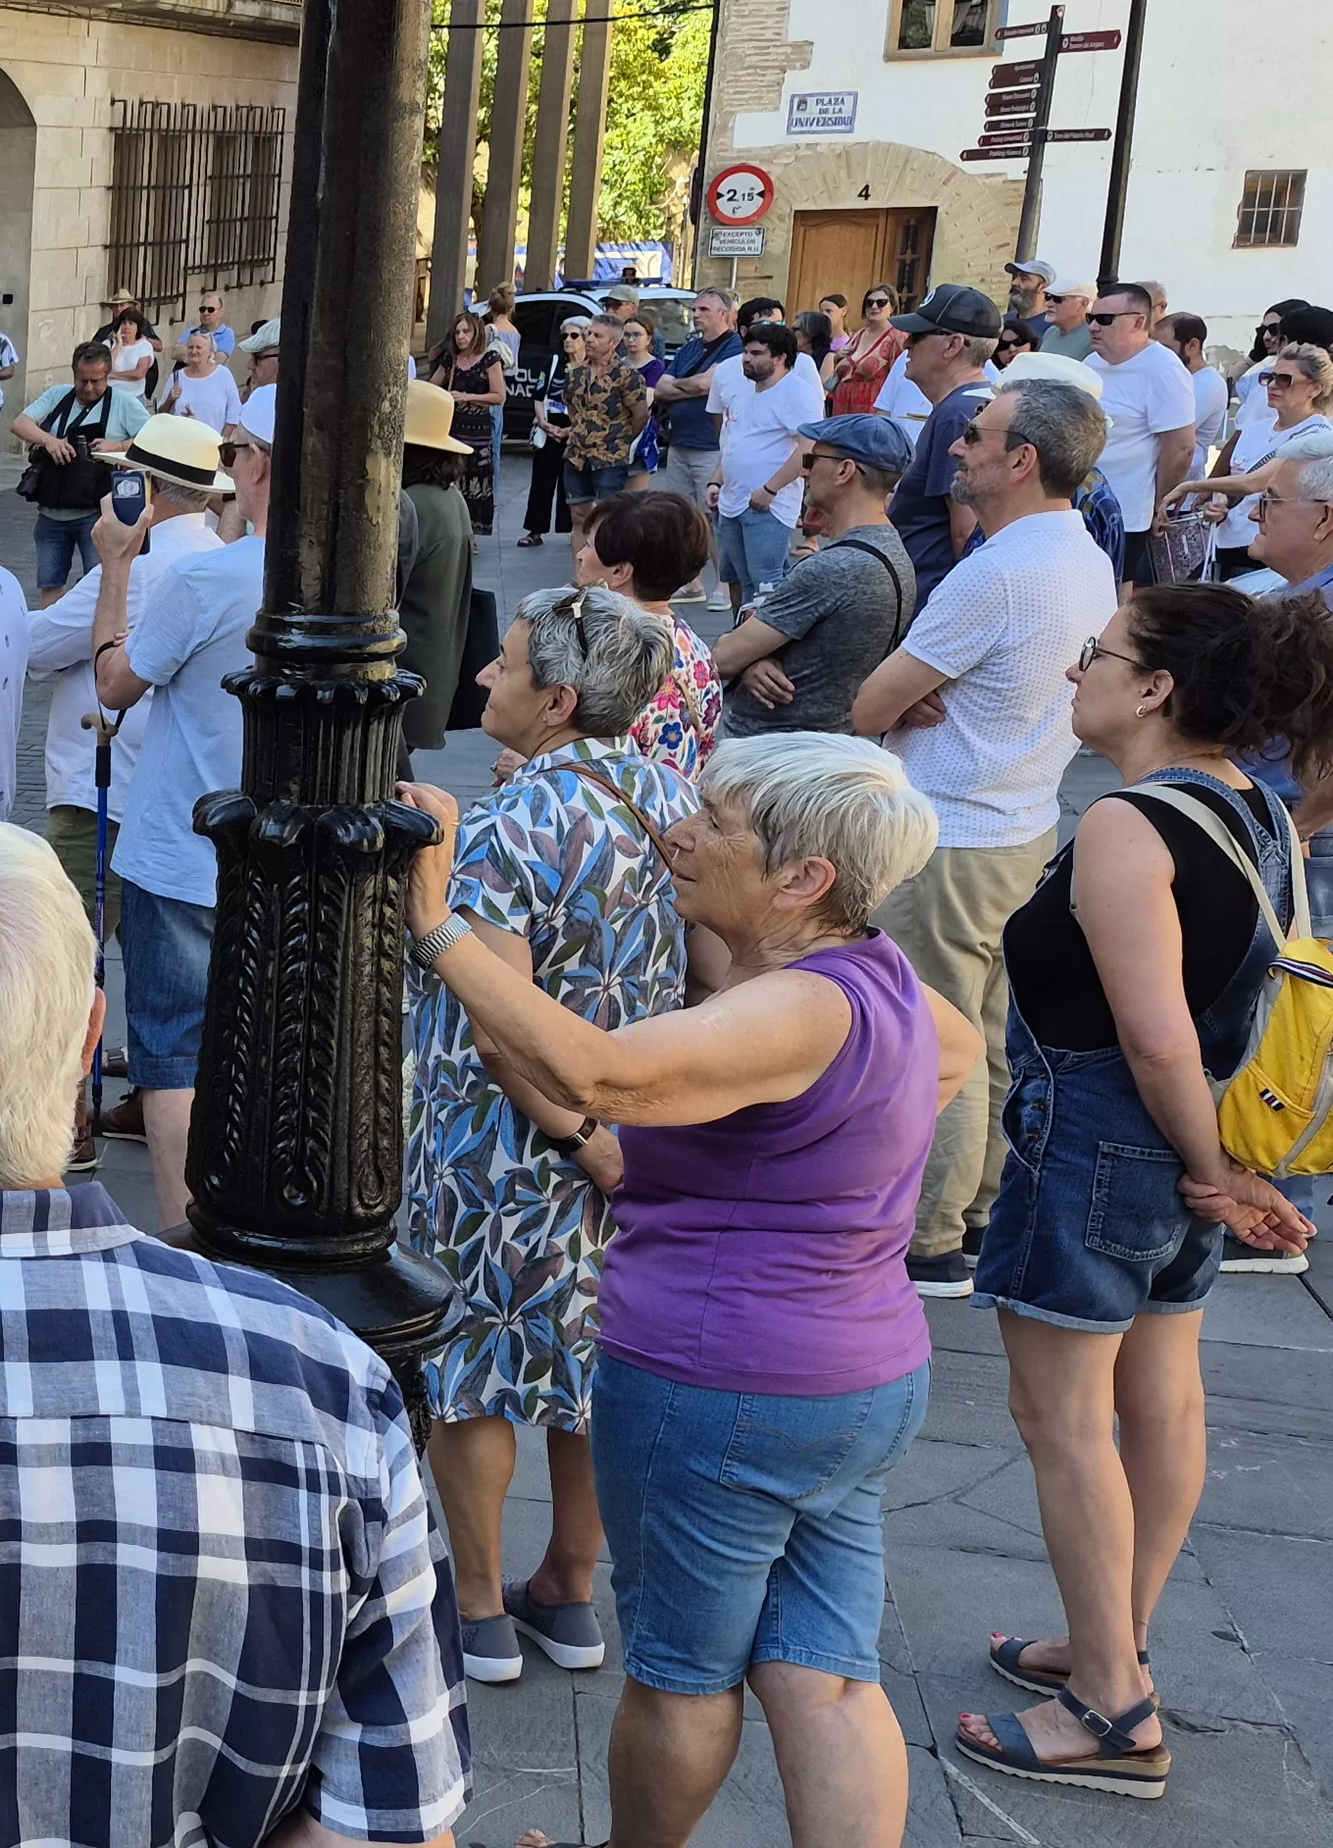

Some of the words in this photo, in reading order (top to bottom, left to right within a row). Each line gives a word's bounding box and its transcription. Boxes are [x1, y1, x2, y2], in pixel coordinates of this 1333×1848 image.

[816, 97, 845, 106] PLAZA
[792, 116, 853, 127] UNIVERSIDAD
[857, 184, 871, 200] 4
